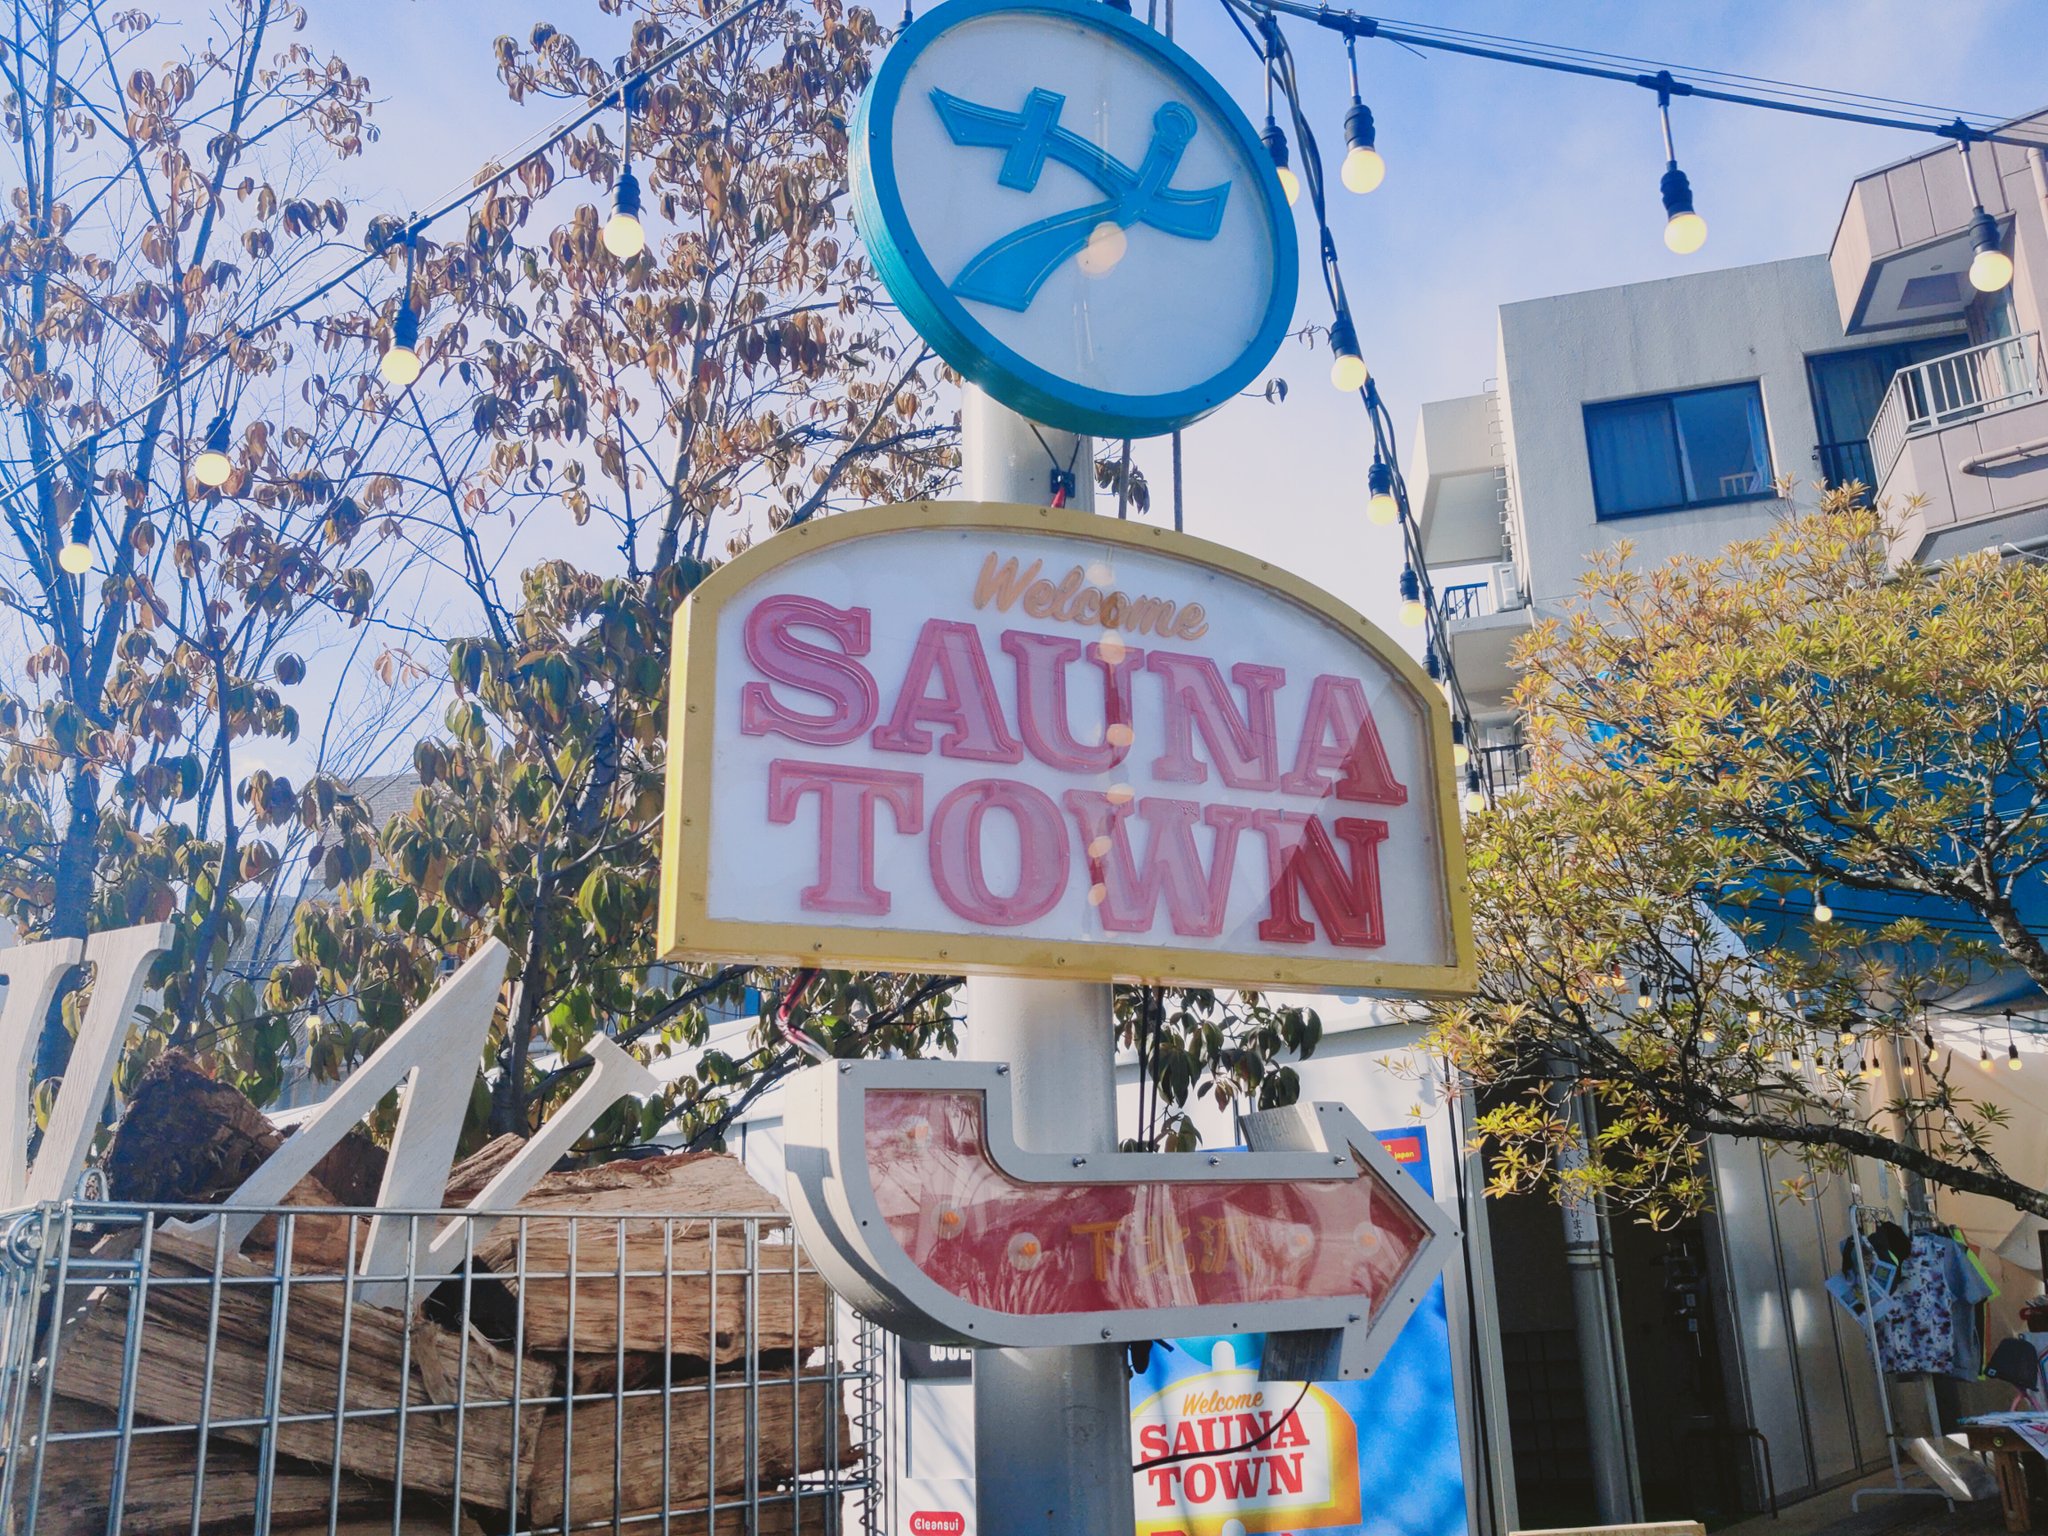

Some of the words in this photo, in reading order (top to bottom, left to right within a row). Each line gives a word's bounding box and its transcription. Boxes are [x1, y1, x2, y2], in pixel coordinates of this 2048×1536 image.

[974, 551, 1209, 642] Welcome
[740, 593, 1408, 806] SAUNA
[767, 758, 1390, 948] TOWN
[1182, 1390, 1265, 1417] Welcome
[1140, 1407, 1311, 1463] SAUNA
[1148, 1452, 1305, 1507] TOWN
[914, 1517, 959, 1531] Cleansui
